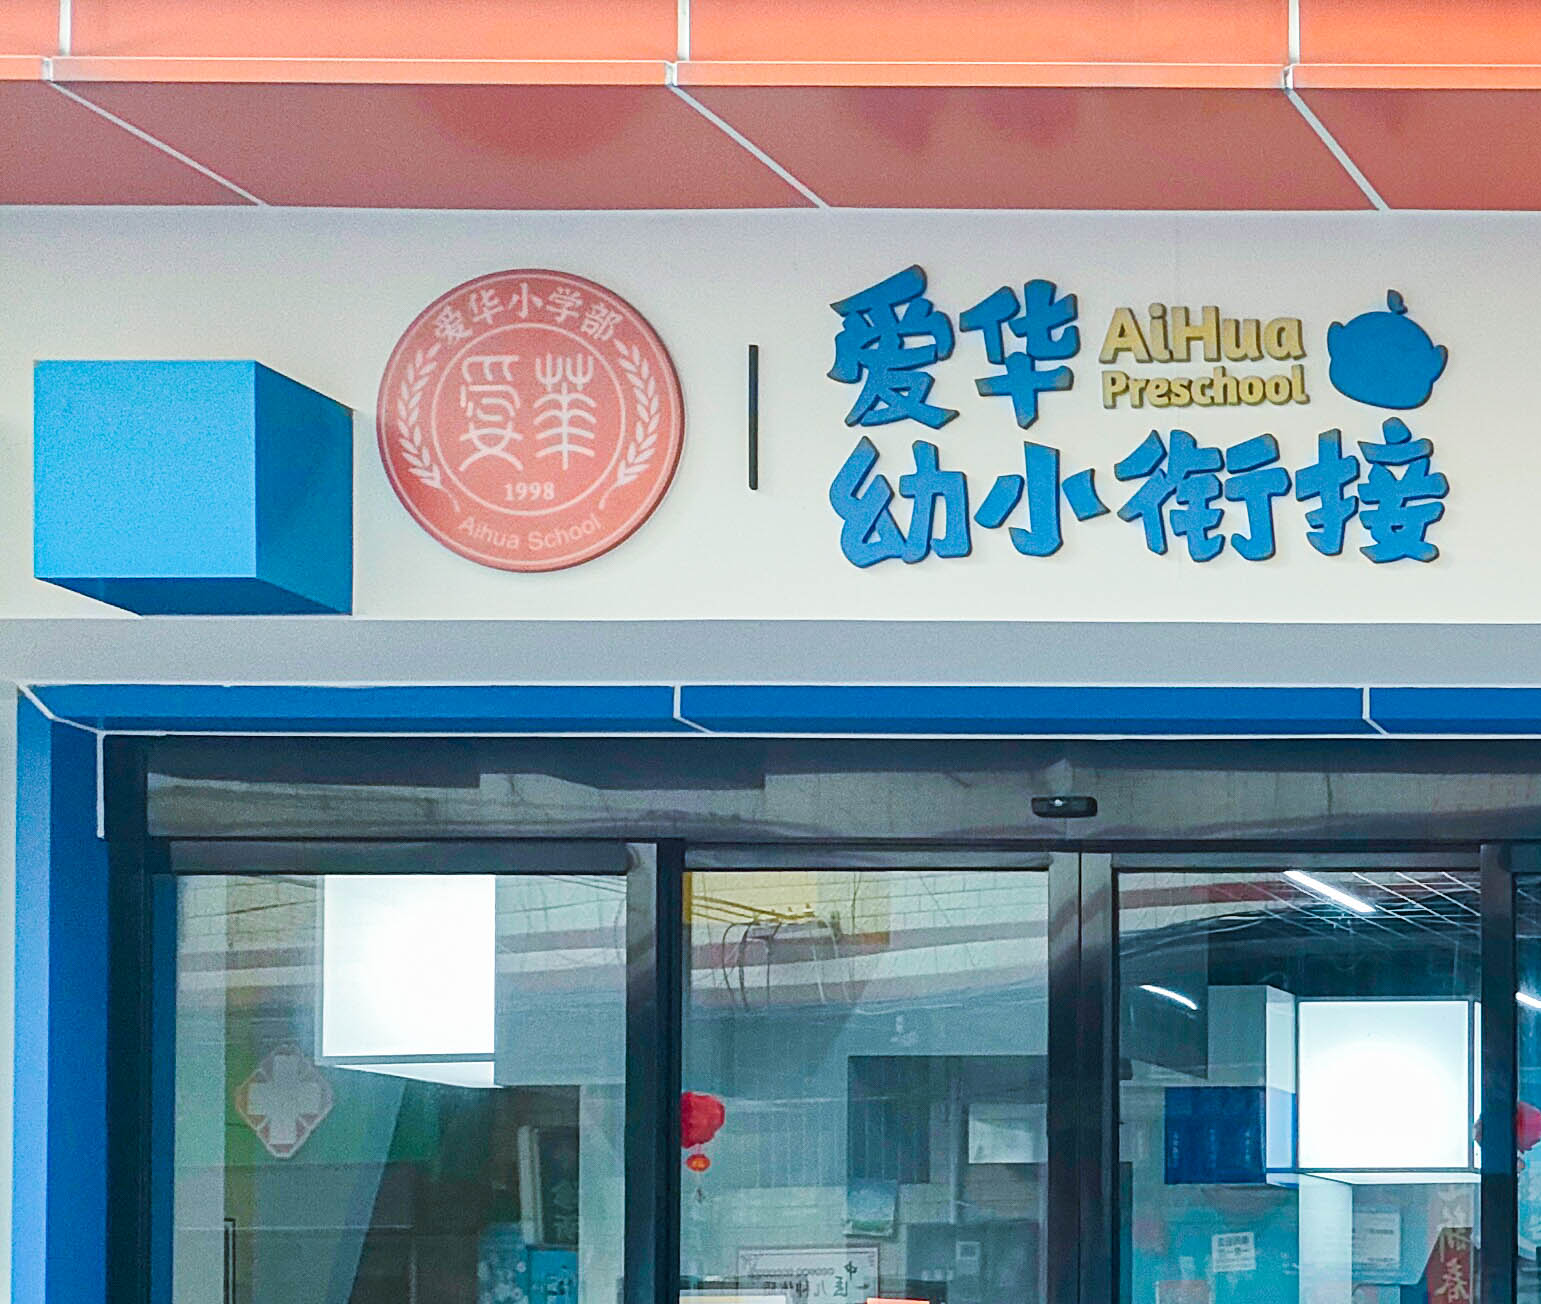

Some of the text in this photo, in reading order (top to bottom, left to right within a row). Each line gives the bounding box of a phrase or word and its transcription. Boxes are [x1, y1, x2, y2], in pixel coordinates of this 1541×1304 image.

[433, 281, 624, 345] 爱华小学部
[1099, 303, 1306, 363] AiHua
[827, 264, 1080, 430] 爱华
[1101, 365, 1310, 410] Preschool
[503, 481, 556, 501] 1998
[829, 417, 1449, 568] 幼小衔接
[458, 513, 605, 551] Aihua School
